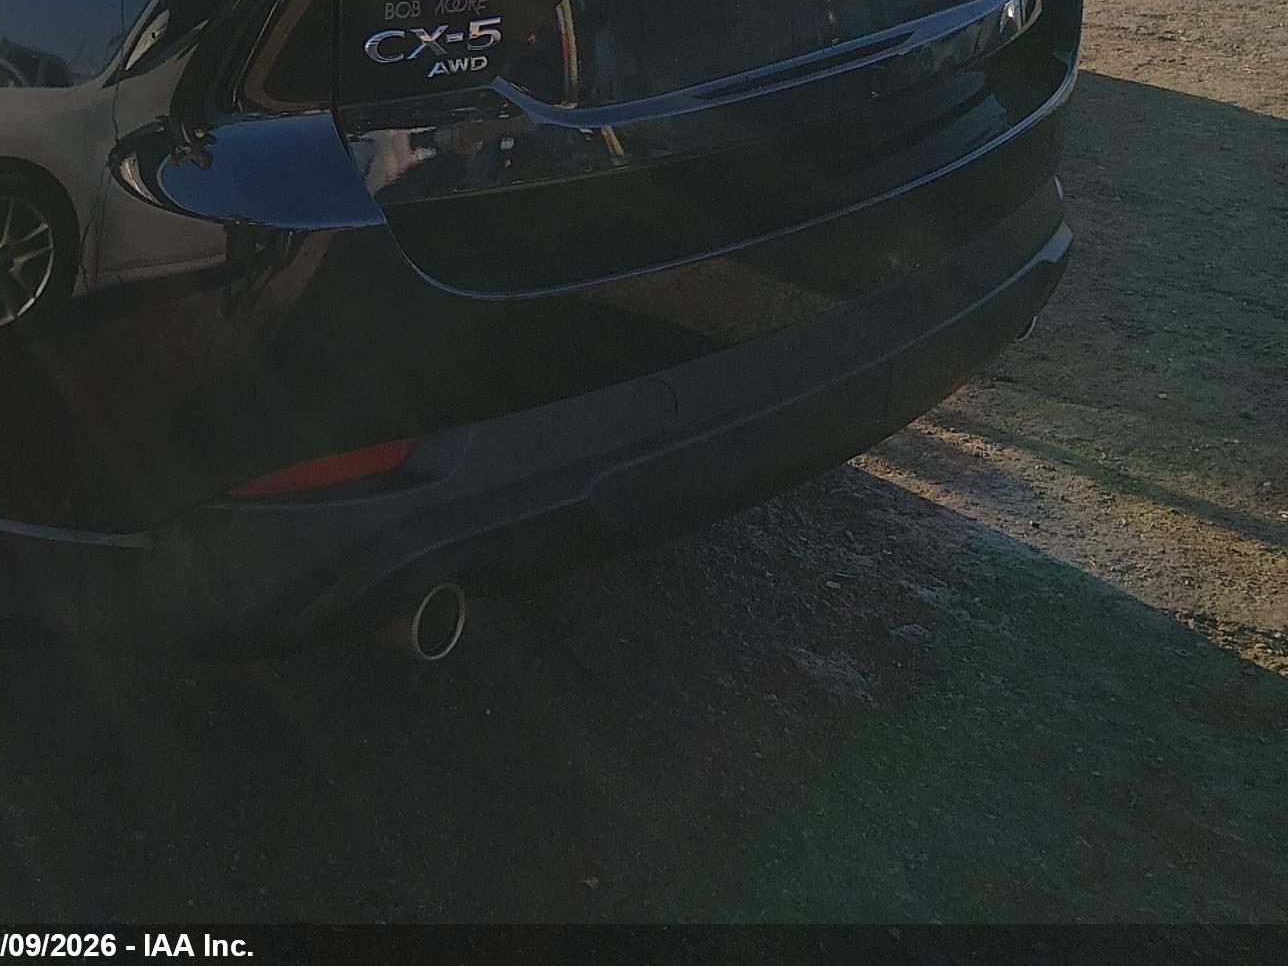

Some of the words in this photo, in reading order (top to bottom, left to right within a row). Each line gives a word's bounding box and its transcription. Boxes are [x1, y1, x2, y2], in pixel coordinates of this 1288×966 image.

[384, 1, 421, 20] BOB
[364, 17, 502, 63] CX-5
[426, 56, 488, 78] AWD
